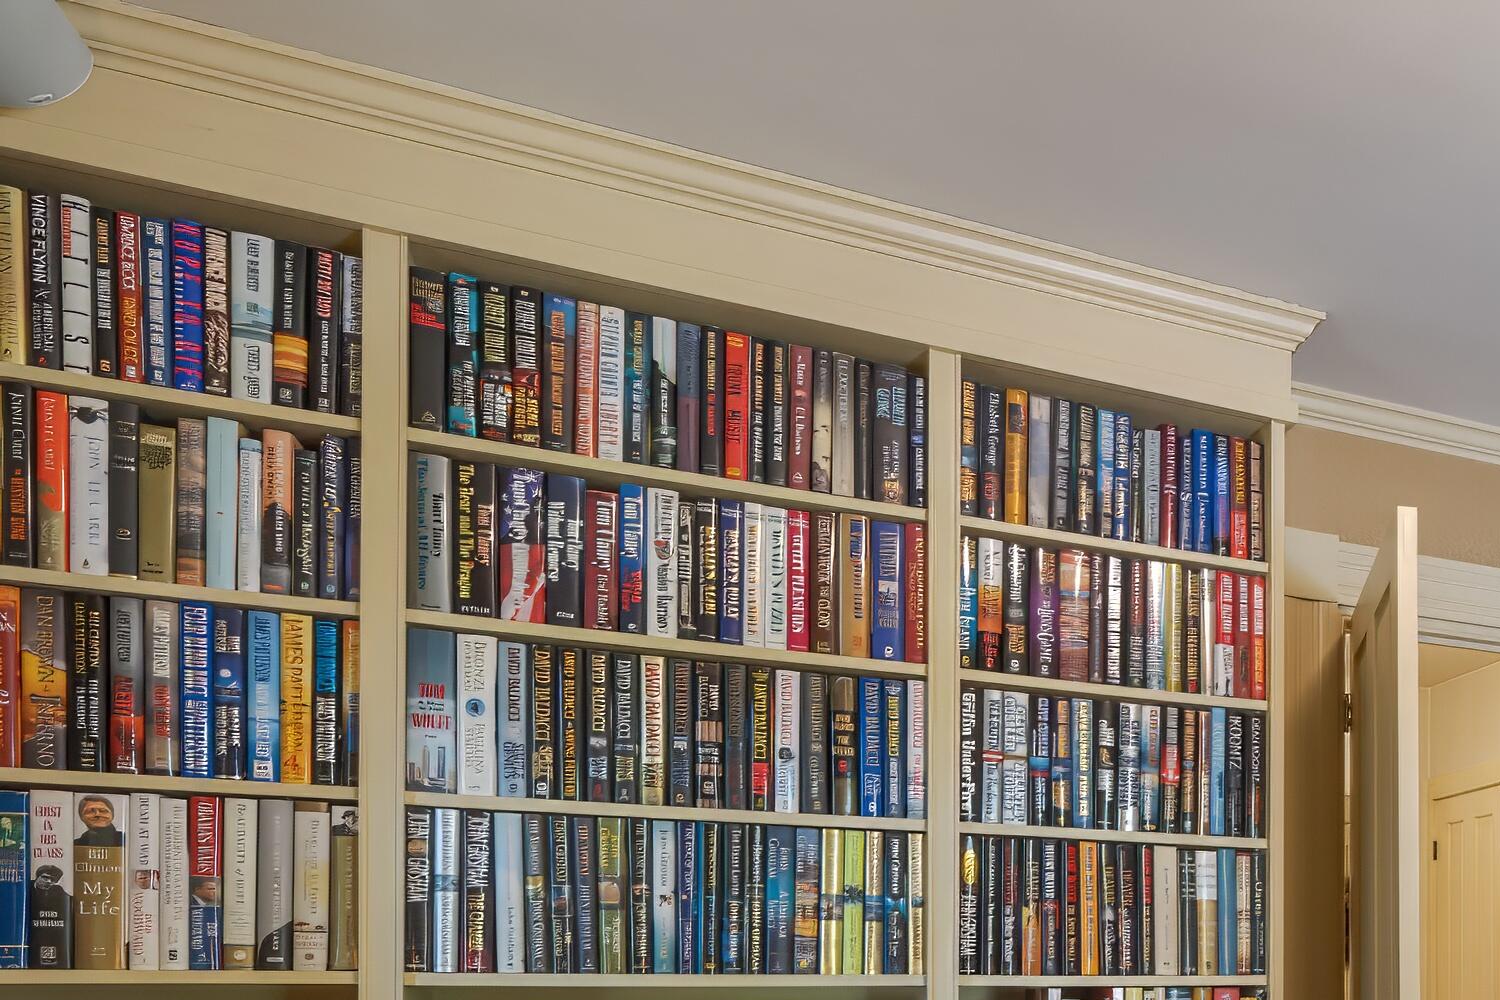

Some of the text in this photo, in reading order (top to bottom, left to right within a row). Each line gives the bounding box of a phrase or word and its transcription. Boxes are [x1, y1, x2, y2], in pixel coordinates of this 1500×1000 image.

[32, 194, 46, 282] VINCE FLYNN
[986, 393, 1000, 466] Elizabeth George
[36, 596, 54, 627] DAN
[535, 651, 551, 683] DAVID
[645, 663, 660, 757] DAVID BALDACCI
[961, 693, 975, 736] Griffin
[407, 812, 429, 902] JOHN GRISHAM
[79, 900, 120, 916] Life
[83, 881, 115, 901] My
